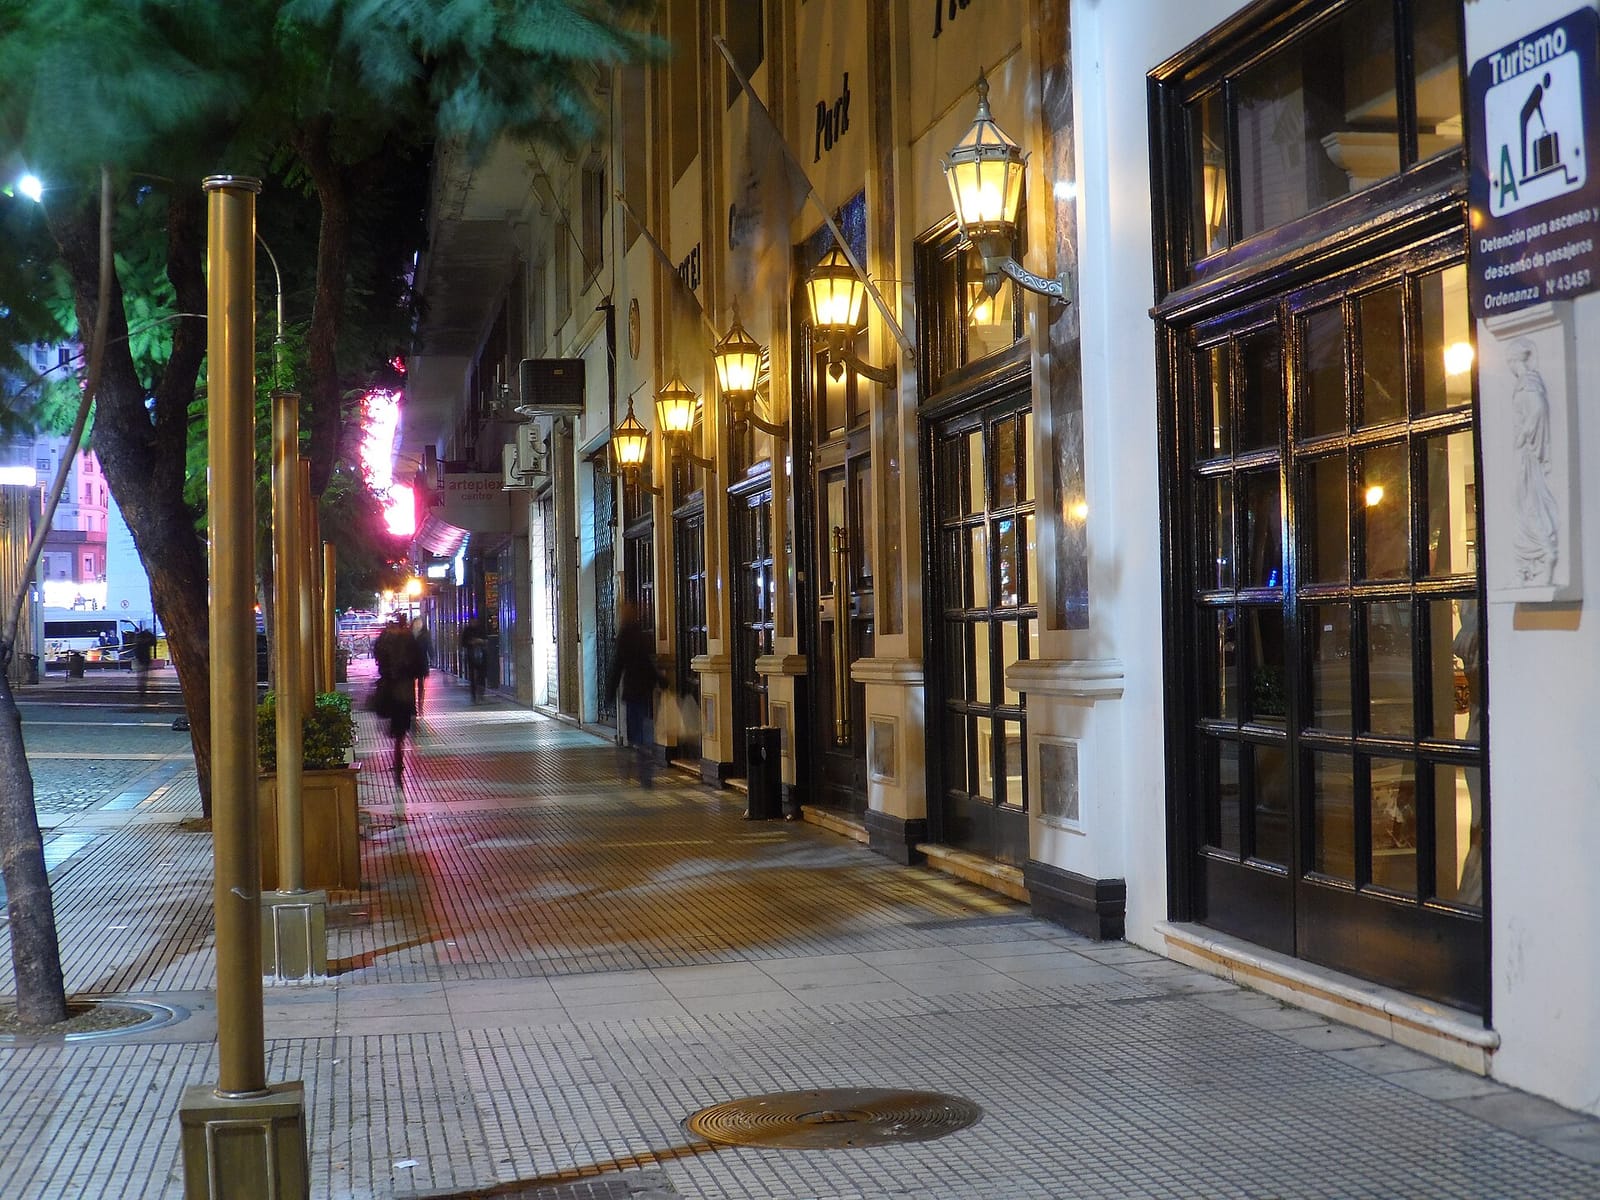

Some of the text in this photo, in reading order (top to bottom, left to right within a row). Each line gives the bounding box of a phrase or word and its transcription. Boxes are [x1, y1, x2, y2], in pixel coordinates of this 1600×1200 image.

[1489, 27, 1567, 86] Turismo
[813, 71, 851, 164] Park
[1499, 144, 1520, 209] A
[1480, 207, 1600, 254] Detención para ascenso y
[1484, 239, 1593, 281] descenso de pasajeros
[1484, 286, 1540, 310] Ordenanza
[448, 479, 503, 492] arteplex
